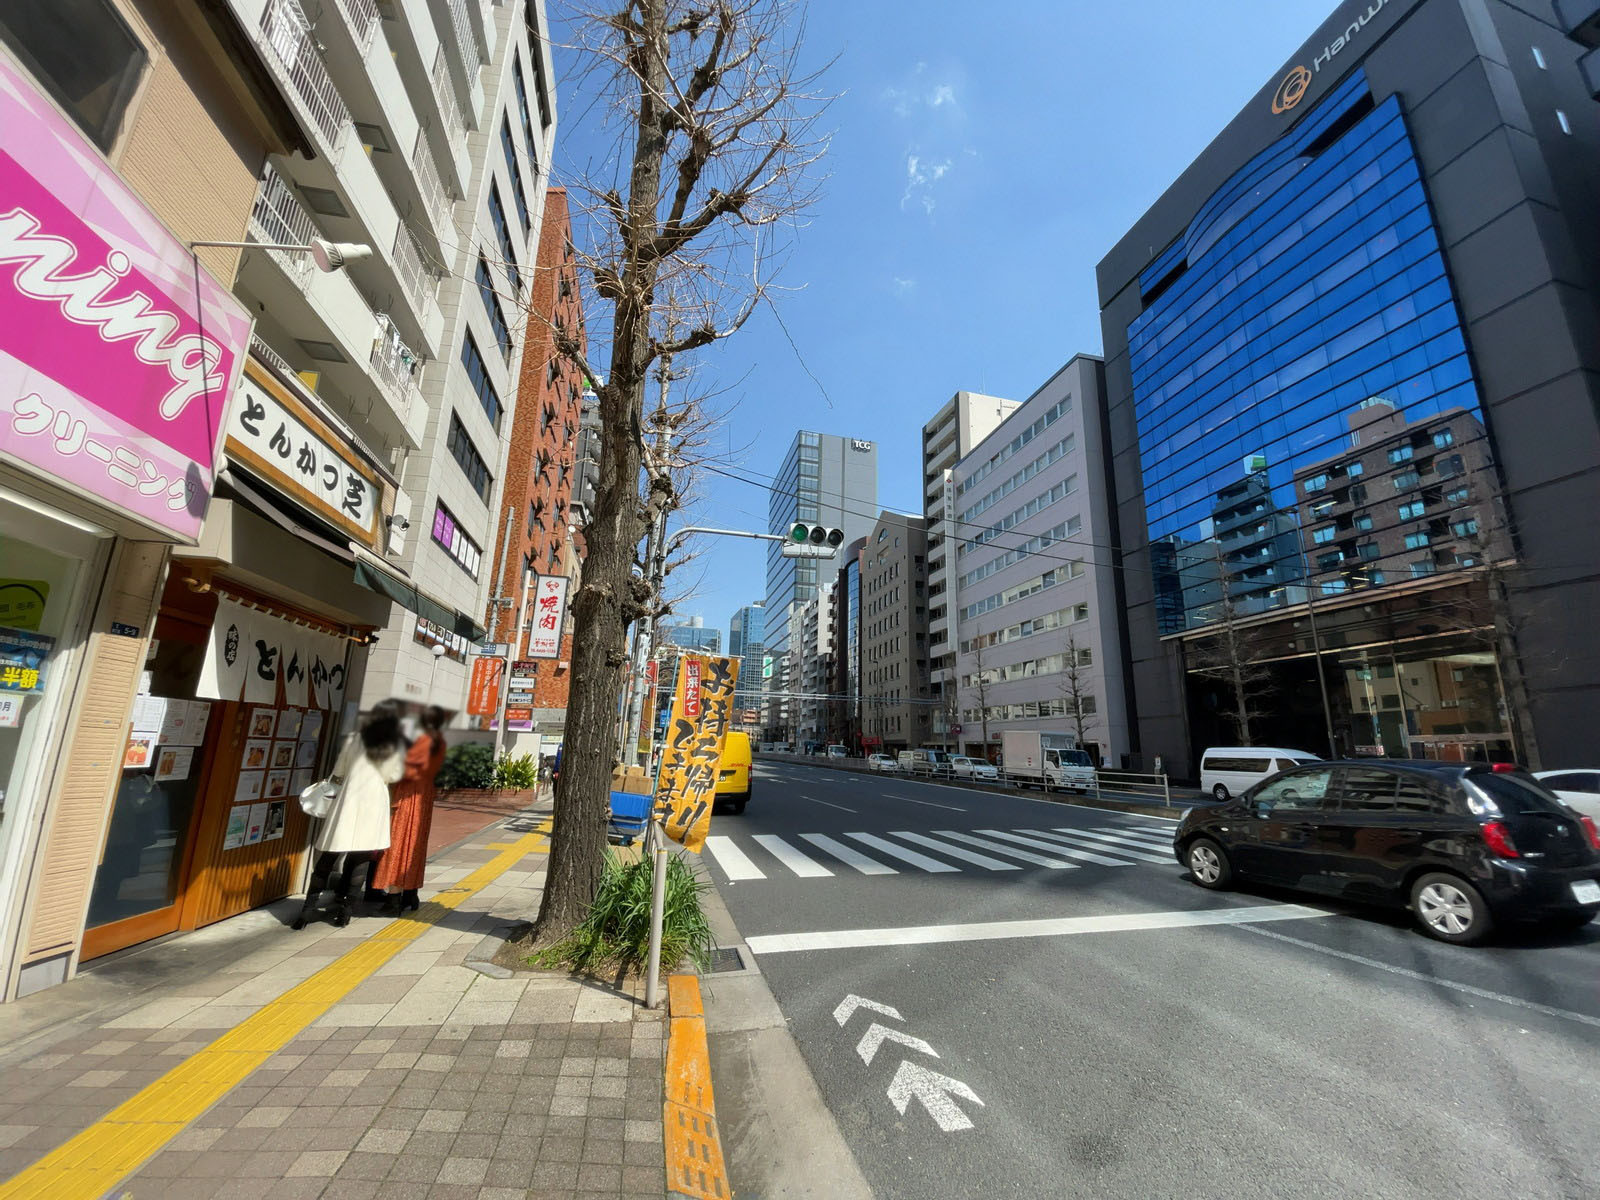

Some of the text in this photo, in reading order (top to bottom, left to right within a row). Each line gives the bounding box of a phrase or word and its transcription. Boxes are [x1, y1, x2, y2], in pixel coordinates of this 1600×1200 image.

[1313, 0, 1389, 73] Hanw
[13, 393, 200, 512] クリーニング
[854, 439, 871, 450] TCG
[539, 595, 560, 631] 焼肉
[2, 666, 39, 689] 半額
[255, 639, 345, 691] とんかつ
[686, 665, 699, 713] 出来たて
[678, 659, 735, 845] お持ち帰り
